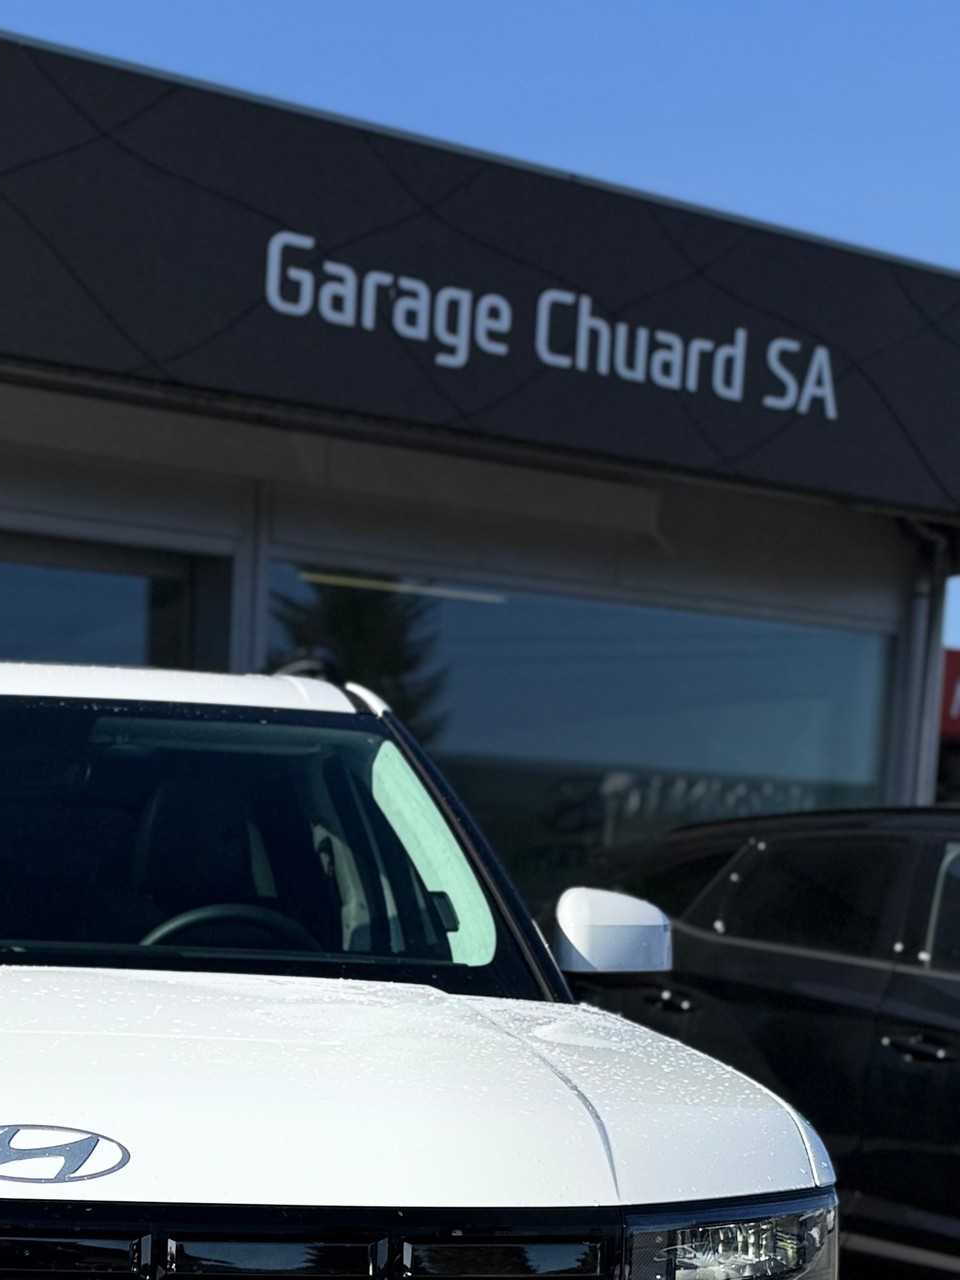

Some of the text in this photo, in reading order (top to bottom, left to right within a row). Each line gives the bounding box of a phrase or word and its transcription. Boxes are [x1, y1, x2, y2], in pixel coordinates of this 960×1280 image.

[265, 230, 838, 420] Garage Chuard SA
